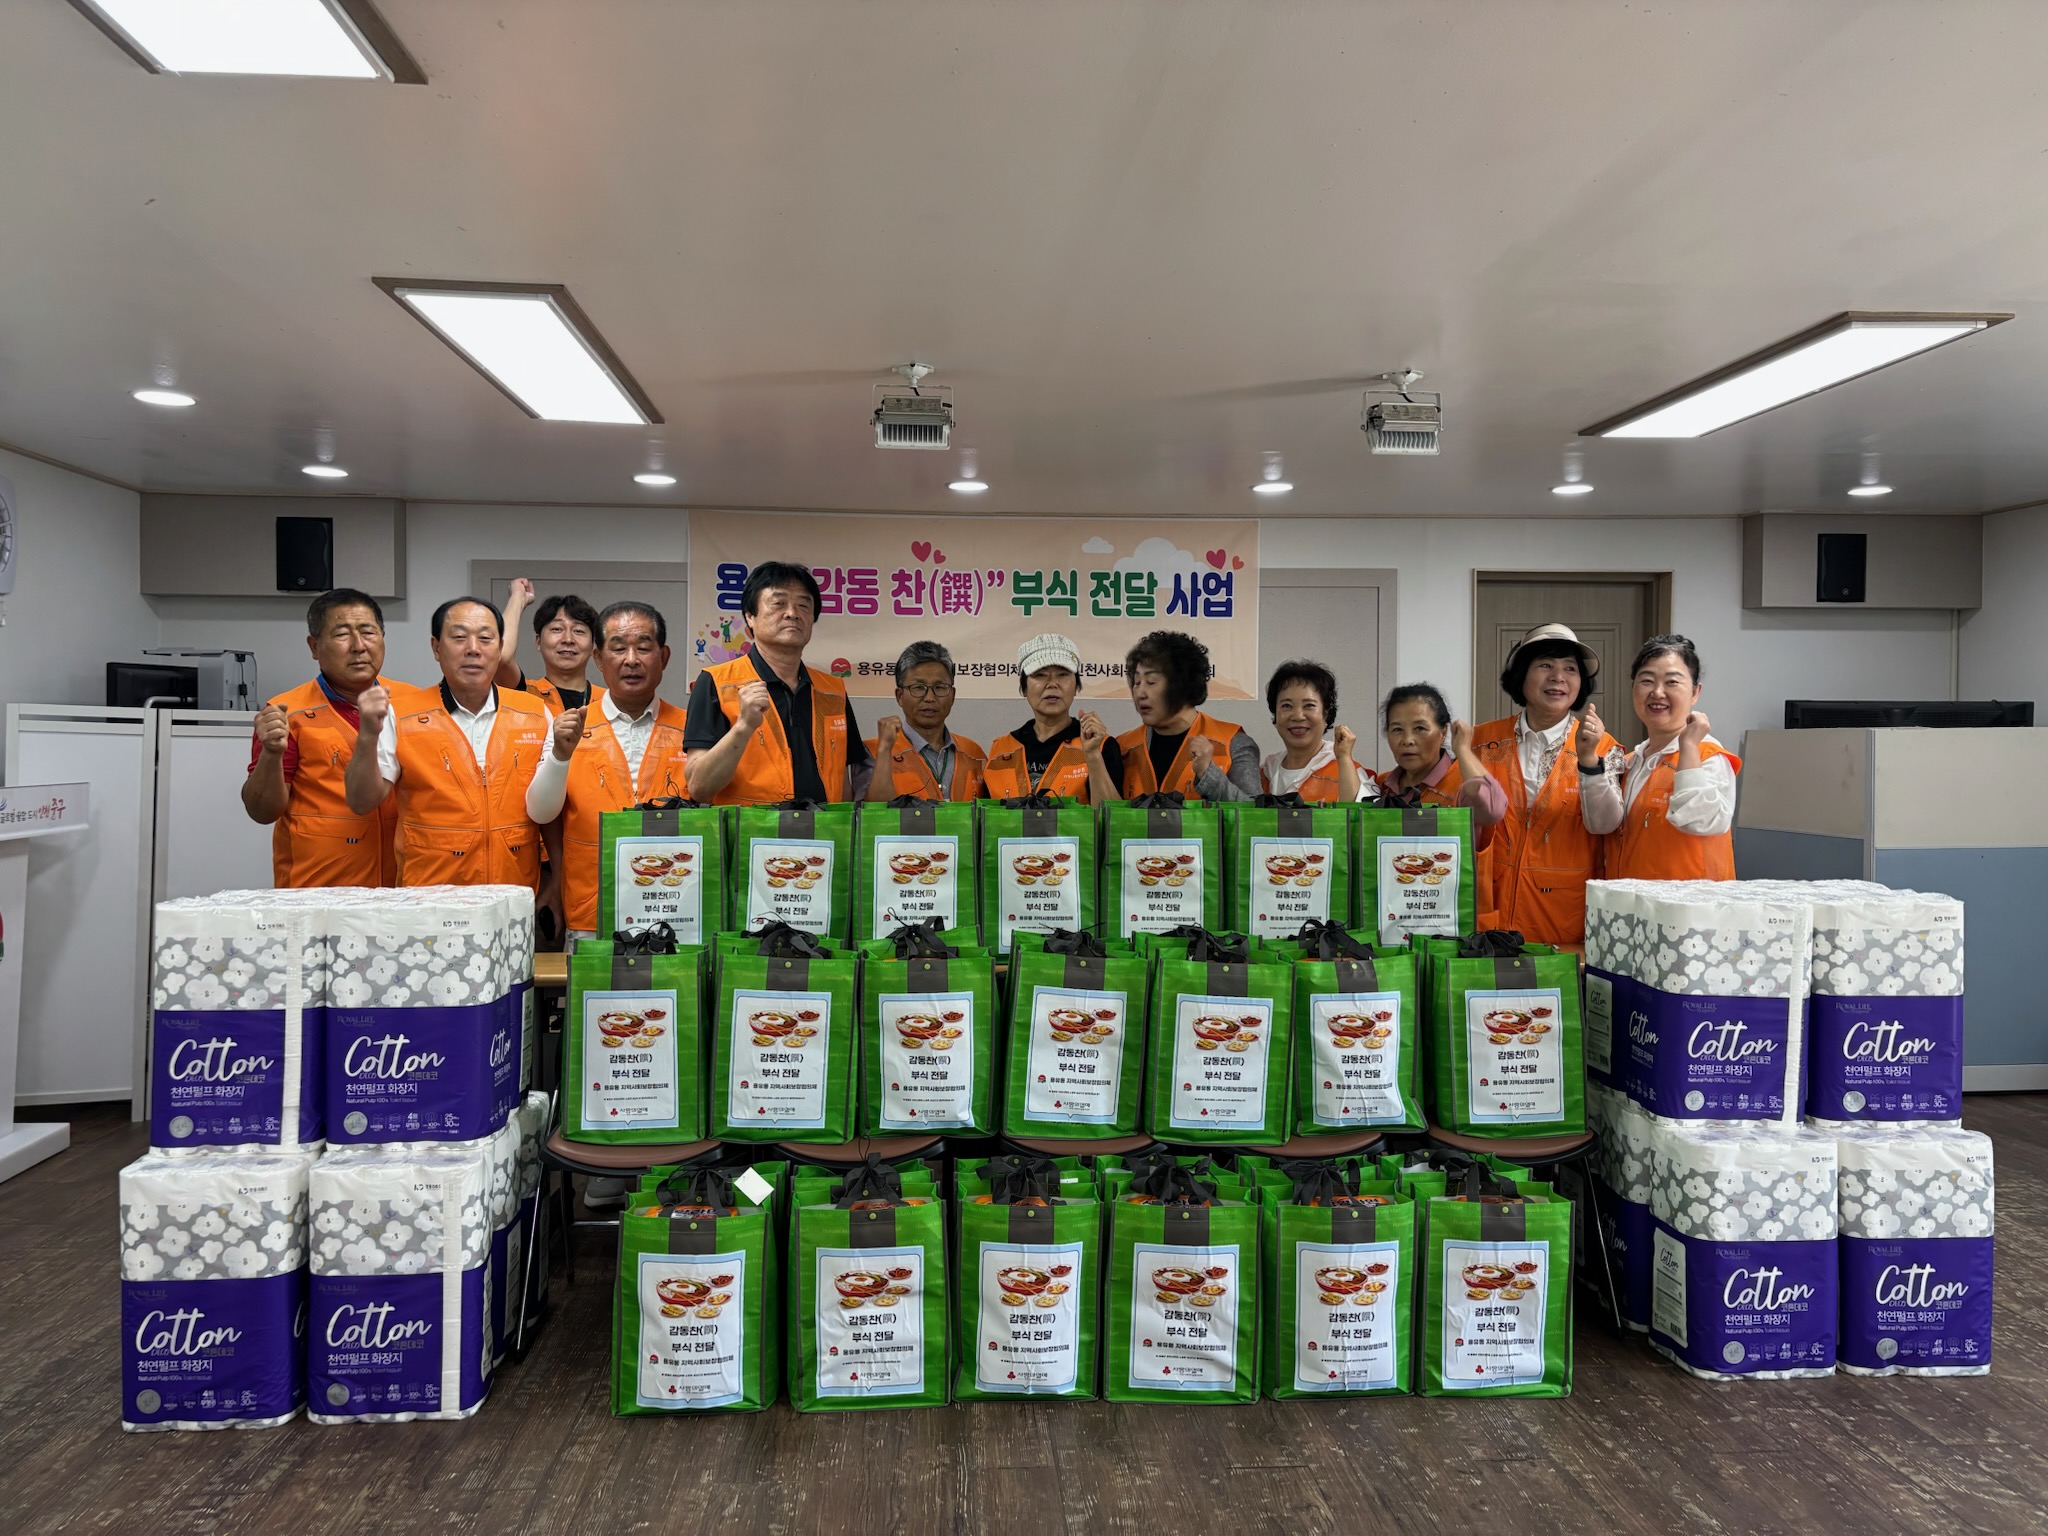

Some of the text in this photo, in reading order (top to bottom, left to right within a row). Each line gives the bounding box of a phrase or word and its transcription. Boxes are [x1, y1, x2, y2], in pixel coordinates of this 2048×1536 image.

[805, 567, 880, 615] 감동
[1012, 570, 1077, 616] 부식
[1089, 571, 1158, 617] 전달
[1166, 571, 1232, 617] 사업
[857, 662, 896, 676] 용유동
[644, 904, 679, 914] 부식 전달
[774, 906, 809, 916] 부식 전달
[901, 902, 935, 912] 부식 전달
[1025, 902, 1059, 912] 부식 전달
[1148, 903, 1181, 912] 부식 전달
[1277, 903, 1309, 912] 부식 전달
[1405, 901, 1437, 911] 부식 전달
[1629, 1010, 1659, 1045] Cotton
[1688, 1020, 1778, 1061] Cotton
[1843, 1020, 1936, 1062] Cotton
[169, 1037, 274, 1081] Cotton
[345, 1034, 445, 1079] Cotton
[611, 1068, 651, 1080] 부식 전달
[761, 1068, 801, 1079] 부식 전달
[1058, 1062, 1097, 1074] 부식 전달
[1343, 1068, 1382, 1080] 부식 전달
[1500, 1063, 1538, 1075] 부식 전달
[1688, 1065, 1752, 1076] 천연펄프 화장지
[1844, 1066, 1911, 1076] 천연펄프 화장지
[910, 1070, 949, 1081] 부식 전달
[1204, 1070, 1242, 1081] 부식 전달
[171, 1086, 245, 1098] 천연펄프 화장지
[346, 1083, 417, 1095] 천연펄프 화장지
[1724, 1266, 1815, 1310] Cotton
[1876, 1263, 1968, 1307] Cotton
[1725, 1314, 1790, 1325] 천연펄프 화장지
[1877, 1310, 1945, 1323] 천연펄프 화장지
[327, 1301, 432, 1348] Cotton
[1476, 1320, 1517, 1333] 부식 전달
[136, 1308, 242, 1356] Cotton
[851, 1330, 895, 1343] 부식 전달
[1010, 1329, 1053, 1342] 부식 전달
[1166, 1325, 1208, 1338] 부식 전달
[1330, 1328, 1373, 1341] 부식 전달
[671, 1340, 715, 1354] 부식 전달
[138, 1359, 213, 1372] 천연펄프 화장지
[328, 1352, 402, 1366] 천연펄프 화장지
